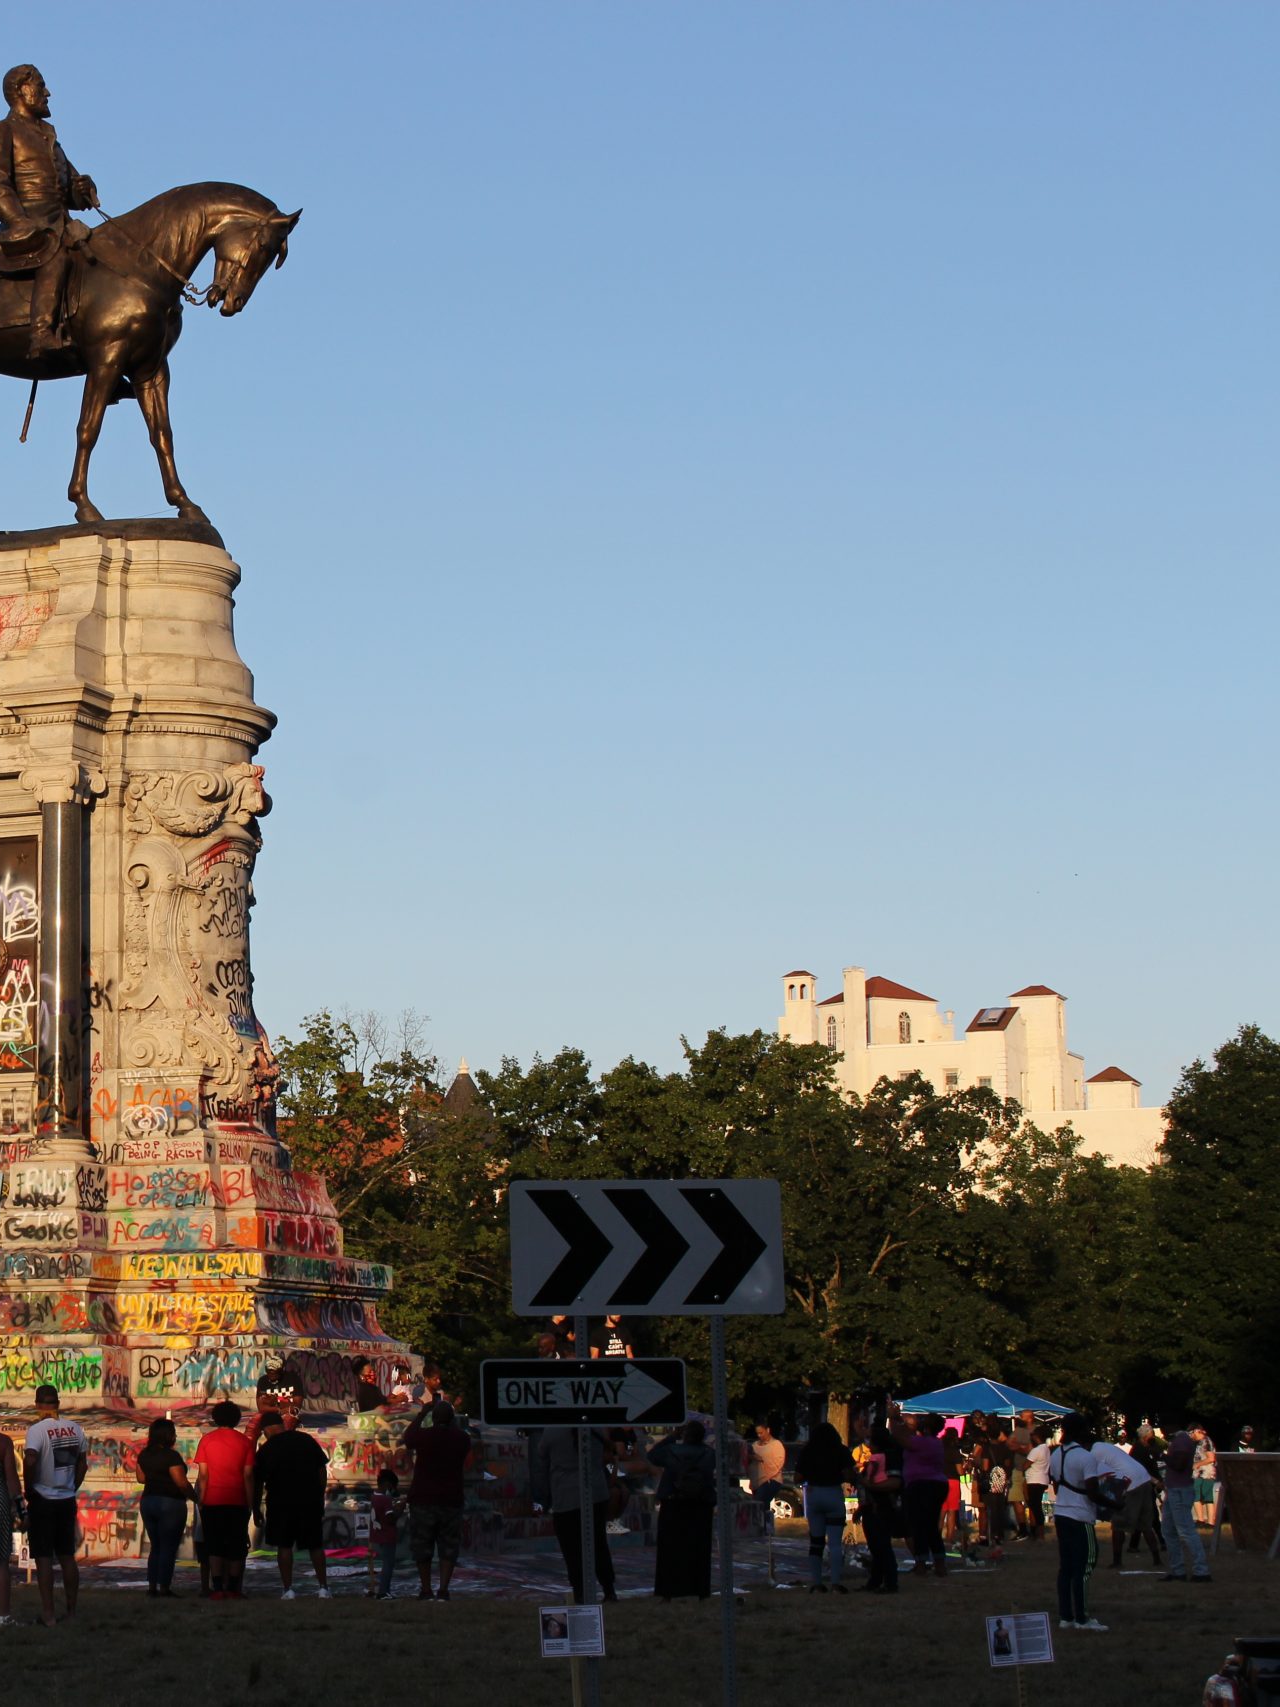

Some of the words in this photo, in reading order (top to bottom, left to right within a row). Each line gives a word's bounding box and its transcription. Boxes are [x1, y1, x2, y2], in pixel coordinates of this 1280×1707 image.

[506, 1381, 558, 1406] ONE
[570, 1381, 624, 1406] WAY
[47, 1426, 76, 1440] PEAK
